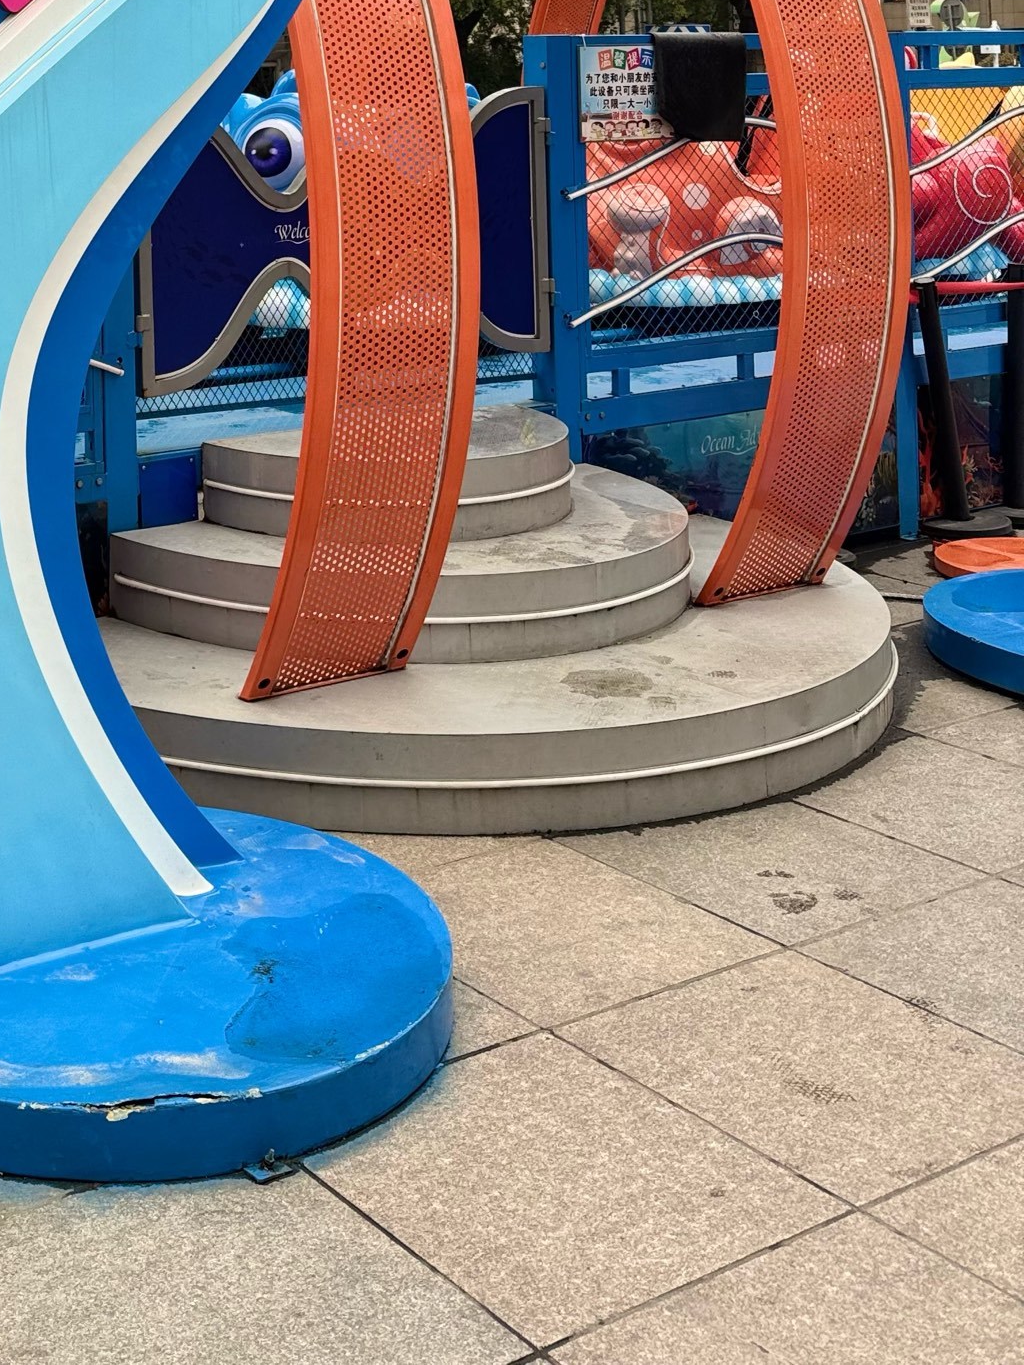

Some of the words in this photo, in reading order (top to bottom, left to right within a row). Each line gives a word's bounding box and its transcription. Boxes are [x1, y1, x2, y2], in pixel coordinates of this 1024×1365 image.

[600, 49, 653, 69] 温馨提示
[612, 110, 643, 120] 谢谢配合
[701, 435, 735, 454] Ocean
